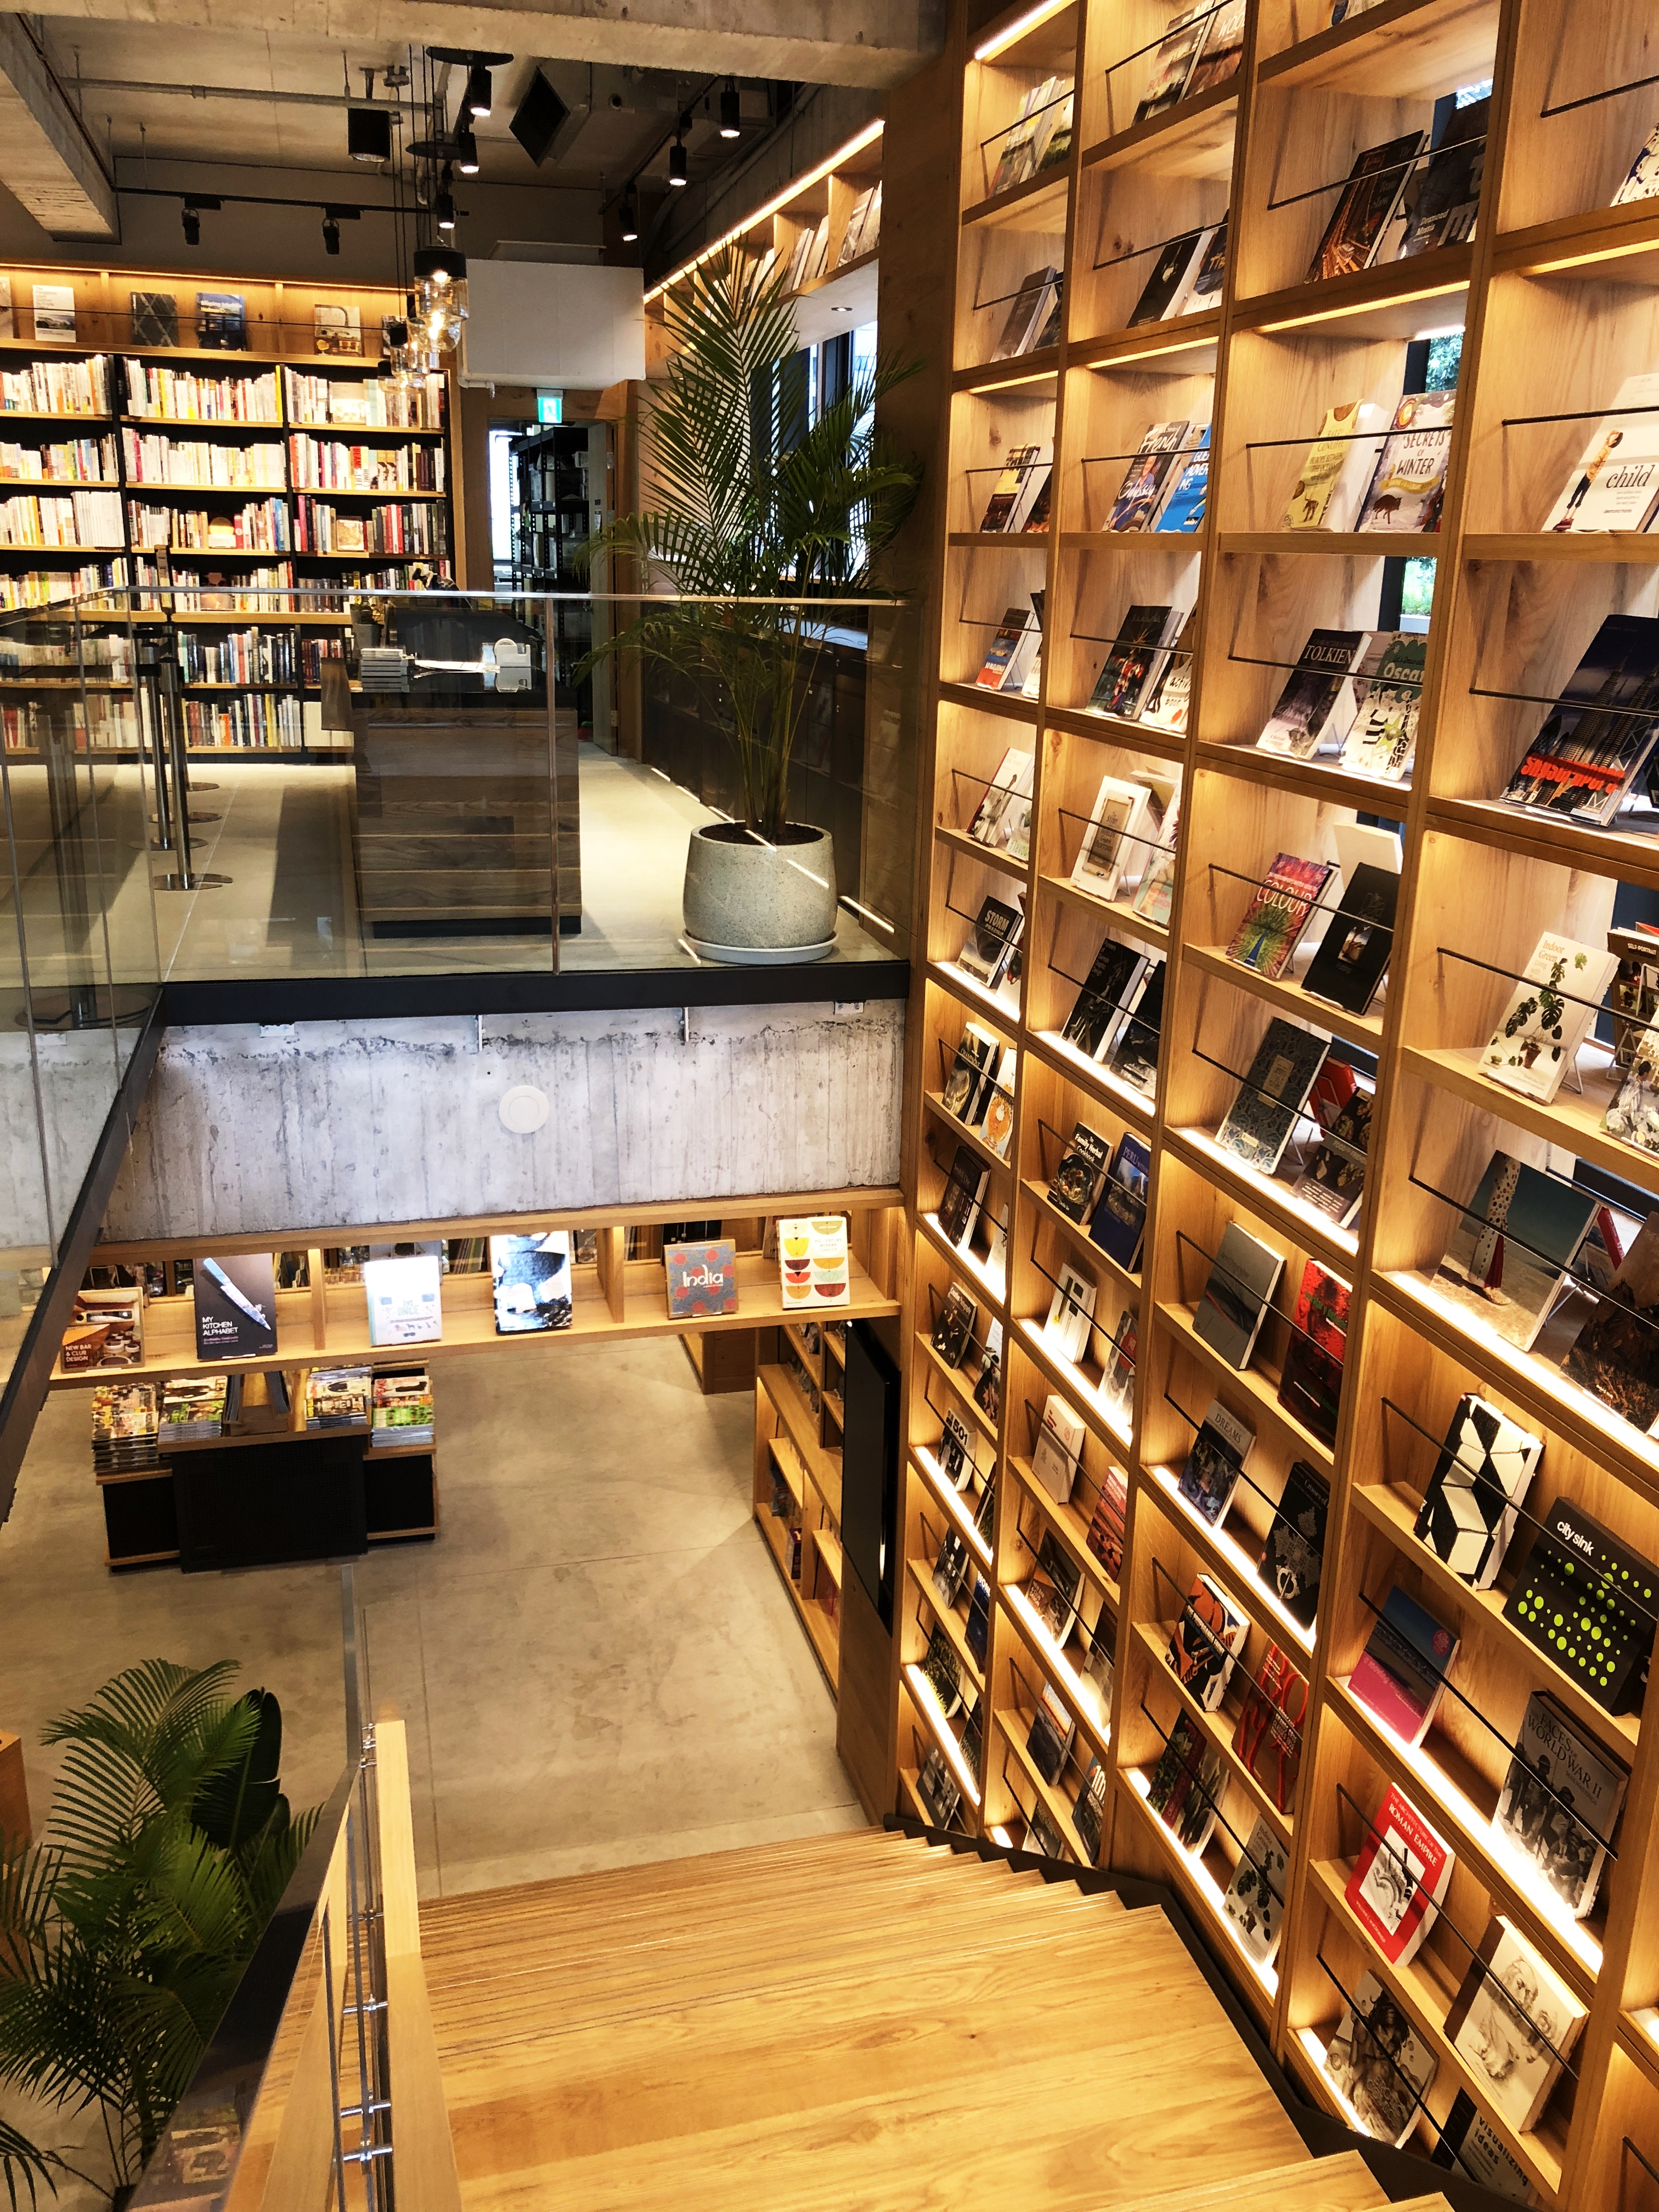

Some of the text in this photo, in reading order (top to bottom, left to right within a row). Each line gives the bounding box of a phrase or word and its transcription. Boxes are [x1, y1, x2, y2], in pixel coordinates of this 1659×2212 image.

[1396, 458, 1435, 476] WINTER
[1606, 465, 1656, 489] child
[1303, 645, 1357, 665] TOLKIEN
[1256, 879, 1313, 917] COLOUR
[985, 909, 1010, 932] STORM
[1538, 950, 1559, 963] Green
[1543, 940, 1565, 955] Indoor
[1074, 1133, 1104, 1159] Family Herbal
[1122, 1146, 1139, 1165] PERU
[682, 1263, 724, 1288] India
[202, 1321, 233, 1330] KITCHEN
[202, 1327, 239, 1336] ALPHABET
[952, 1418, 968, 1446] 501
[1214, 1413, 1242, 1444] DREAMS
[1556, 1521, 1595, 1556] city sink
[1540, 1713, 1572, 1752] FACES
[1527, 1714, 1602, 1799] WORLD WAR II
[1388, 1802, 1438, 1867] ROMAN EMPIRE
[1390, 1791, 1400, 1804] THE
[1397, 1798, 1427, 1839] ARCHITECTURE
[1432, 1844, 1443, 1859] THE
[1474, 2127, 1499, 2165] ideas
[1478, 2115, 1529, 2187] visualizing
